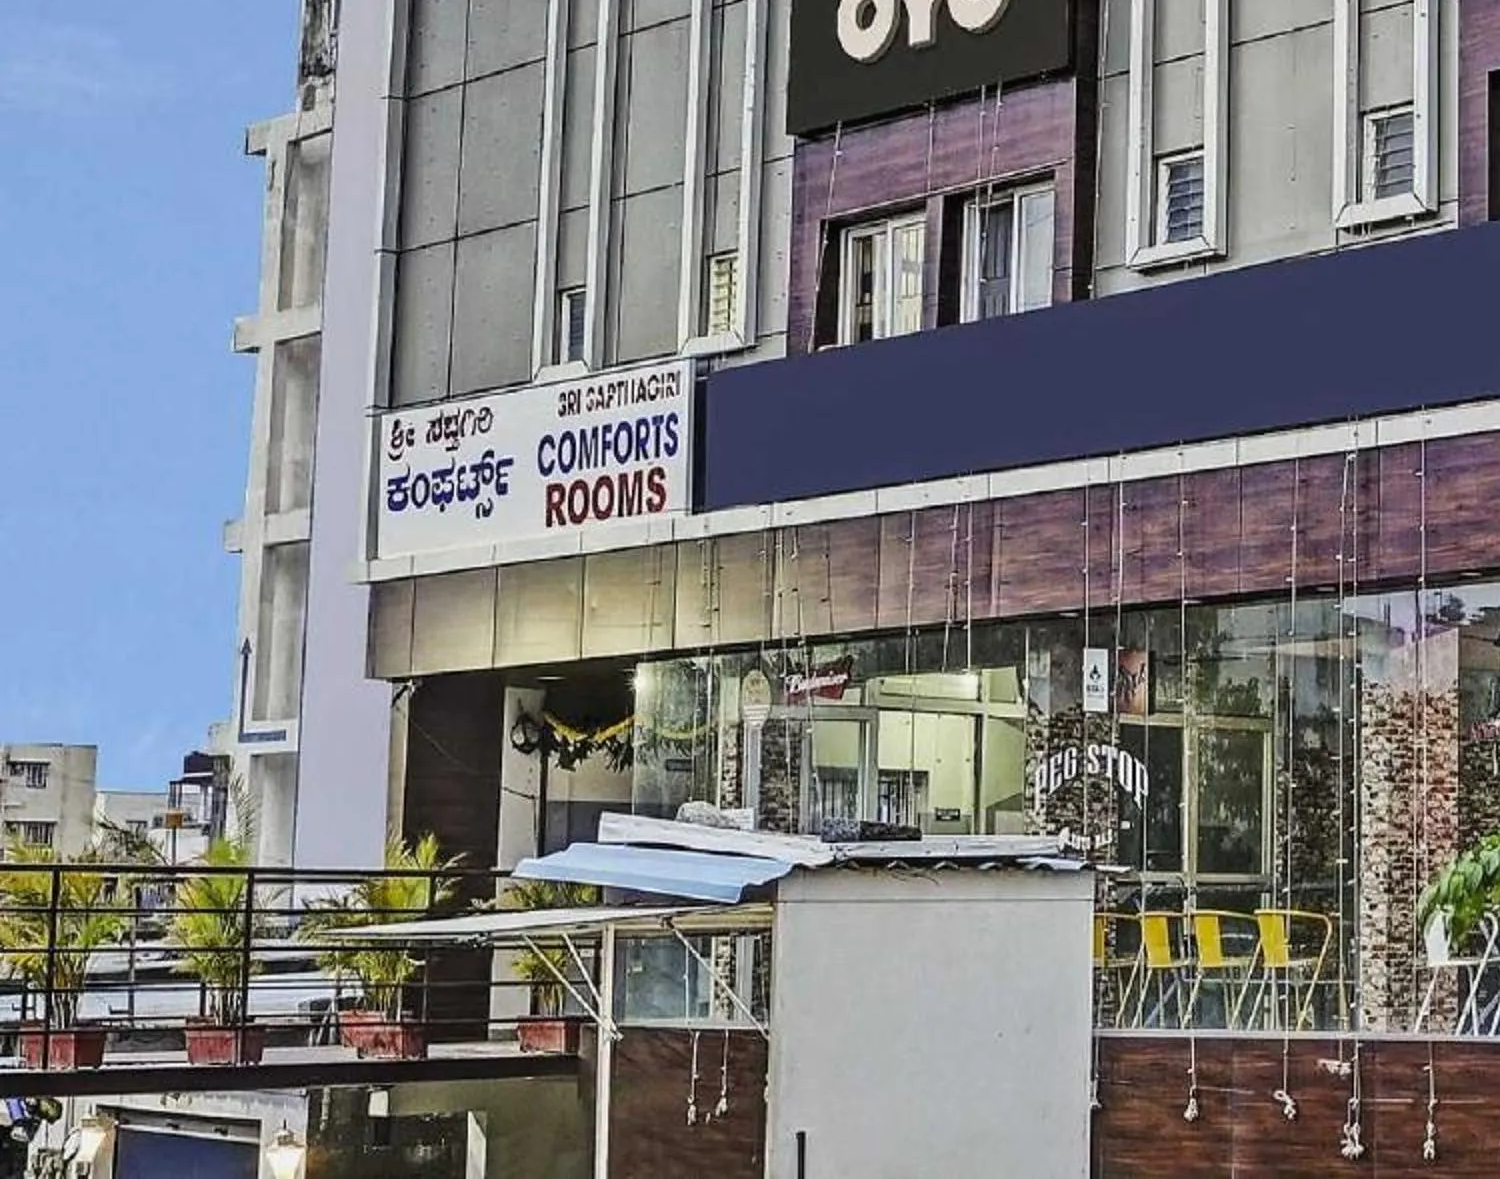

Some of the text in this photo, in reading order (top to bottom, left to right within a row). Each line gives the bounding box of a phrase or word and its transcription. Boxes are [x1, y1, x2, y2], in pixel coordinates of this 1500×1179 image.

[557, 388, 581, 418] SRI
[388, 419, 415, 461] ಶ್ರೀ
[537, 412, 679, 477] COMFORTS
[545, 466, 667, 528] ROOMS
[1087, 743, 1149, 811] STOP
